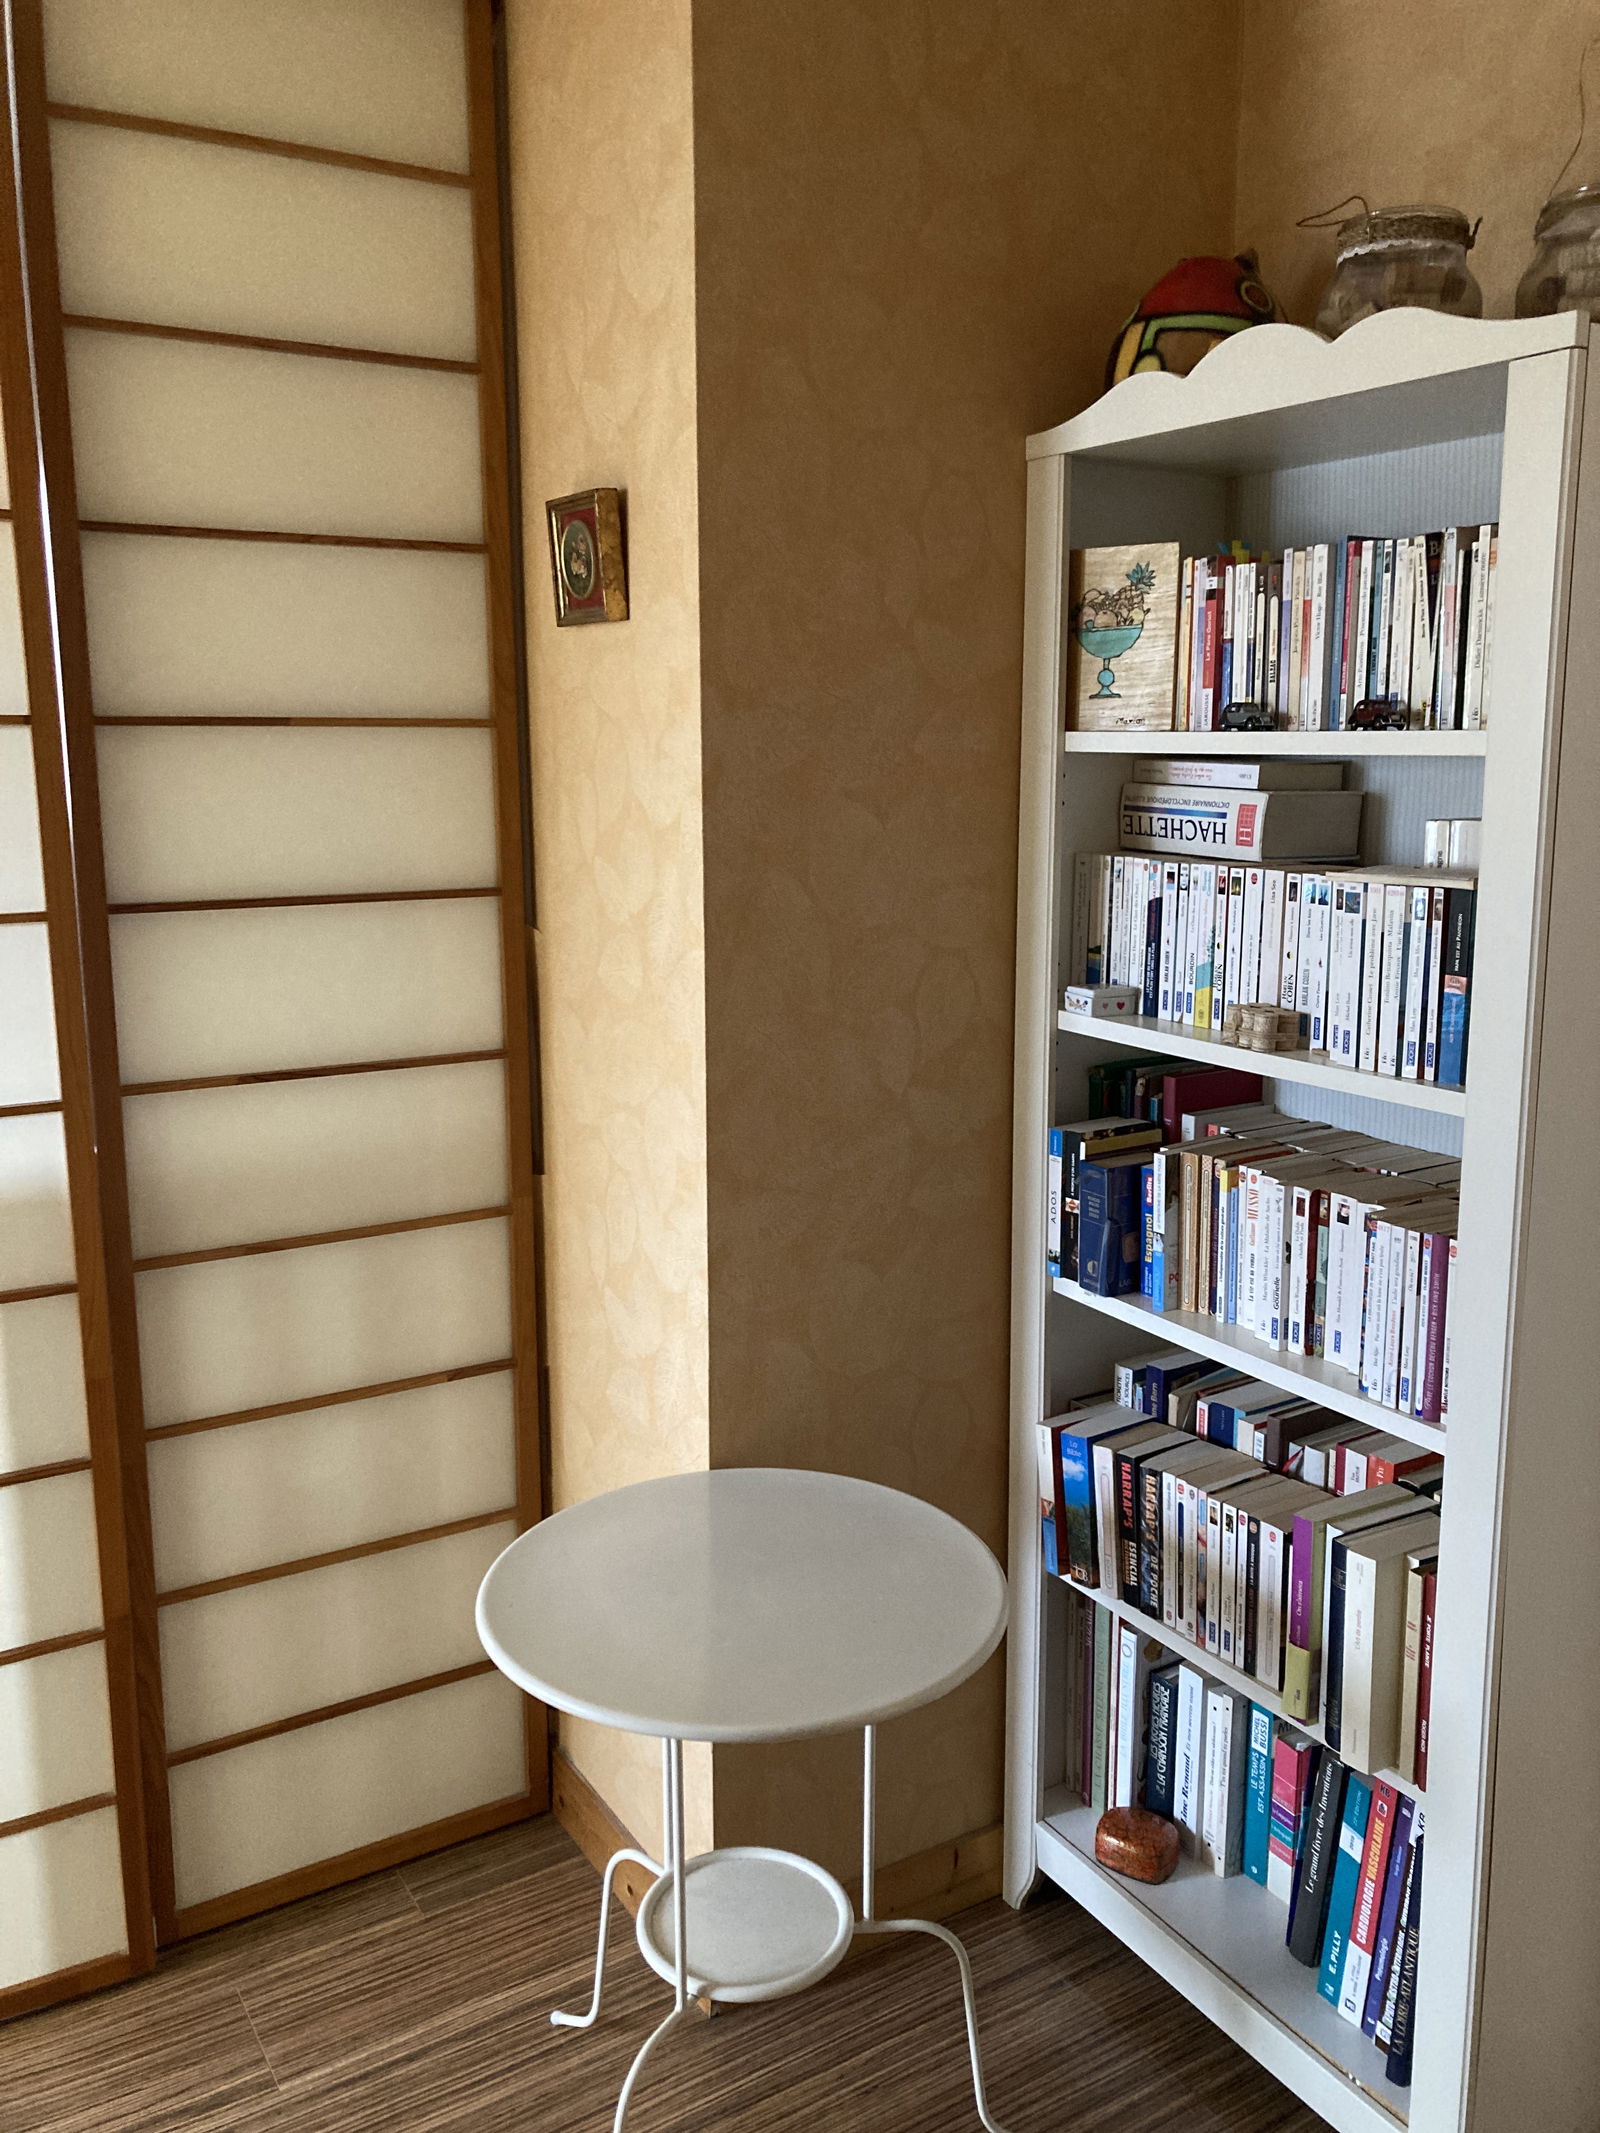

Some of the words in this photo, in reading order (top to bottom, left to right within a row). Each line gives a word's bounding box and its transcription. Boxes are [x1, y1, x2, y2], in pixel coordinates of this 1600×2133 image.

[1192, 800, 1230, 809] DICTIONNAIRE
[1123, 815, 1227, 844] HACHETTE
[1188, 952, 1196, 985] BOURDIN
[1286, 973, 1294, 1004] COBEN
[1406, 1041, 1415, 1067] POCKET
[1145, 1176, 1153, 1204] Berlitz
[1247, 1189, 1259, 1220] MUSSO
[1144, 1213, 1154, 1263] Espagnol
[1273, 1277, 1281, 1310] Gounelle
[1430, 1320, 1438, 1340] BERGER
[1400, 1376, 1409, 1402] POCKET
[1121, 1461, 1133, 1529] HARRAP'S
[1145, 1473, 1158, 1542] HARRAP'S
[1129, 1541, 1137, 1587] ESENCIAL
[1150, 1555, 1158, 1567] DE
[1150, 1572, 1158, 1609] POCHE
[1296, 1607, 1302, 1617] On
[1151, 1682, 1161, 1716] HEURES
[1150, 1715, 1159, 1745] RICHES
[1252, 1716, 1260, 1745] MICHEL
[1259, 1719, 1267, 1749] BUSSI
[1150, 1744, 1158, 1760] LES
[1156, 1731, 1168, 1773] CHANSON
[1251, 1751, 1259, 1780] TEMPS
[1156, 1776, 1166, 1787] LA
[1181, 1752, 1191, 1799] Renaud
[1250, 1780, 1258, 1790] LE
[1258, 1755, 1267, 1797] ASSASSIN
[1318, 1762, 1334, 1811] Inventions
[1378, 1784, 1392, 1798] KB
[1179, 1799, 1188, 1826] Line
[1315, 1812, 1326, 1828] des
[1311, 1829, 1323, 1851] livre
[1308, 1851, 1321, 1880] grand
[1304, 1879, 1314, 1894] Le
[1356, 1879, 1375, 1945] CARDIOLOGIE
[1366, 1817, 1385, 1880] VASCULAIRE
[1393, 1925, 1419, 2037] LOIRE-ATLANTIQUE
[1391, 2038, 1403, 2057] LA
